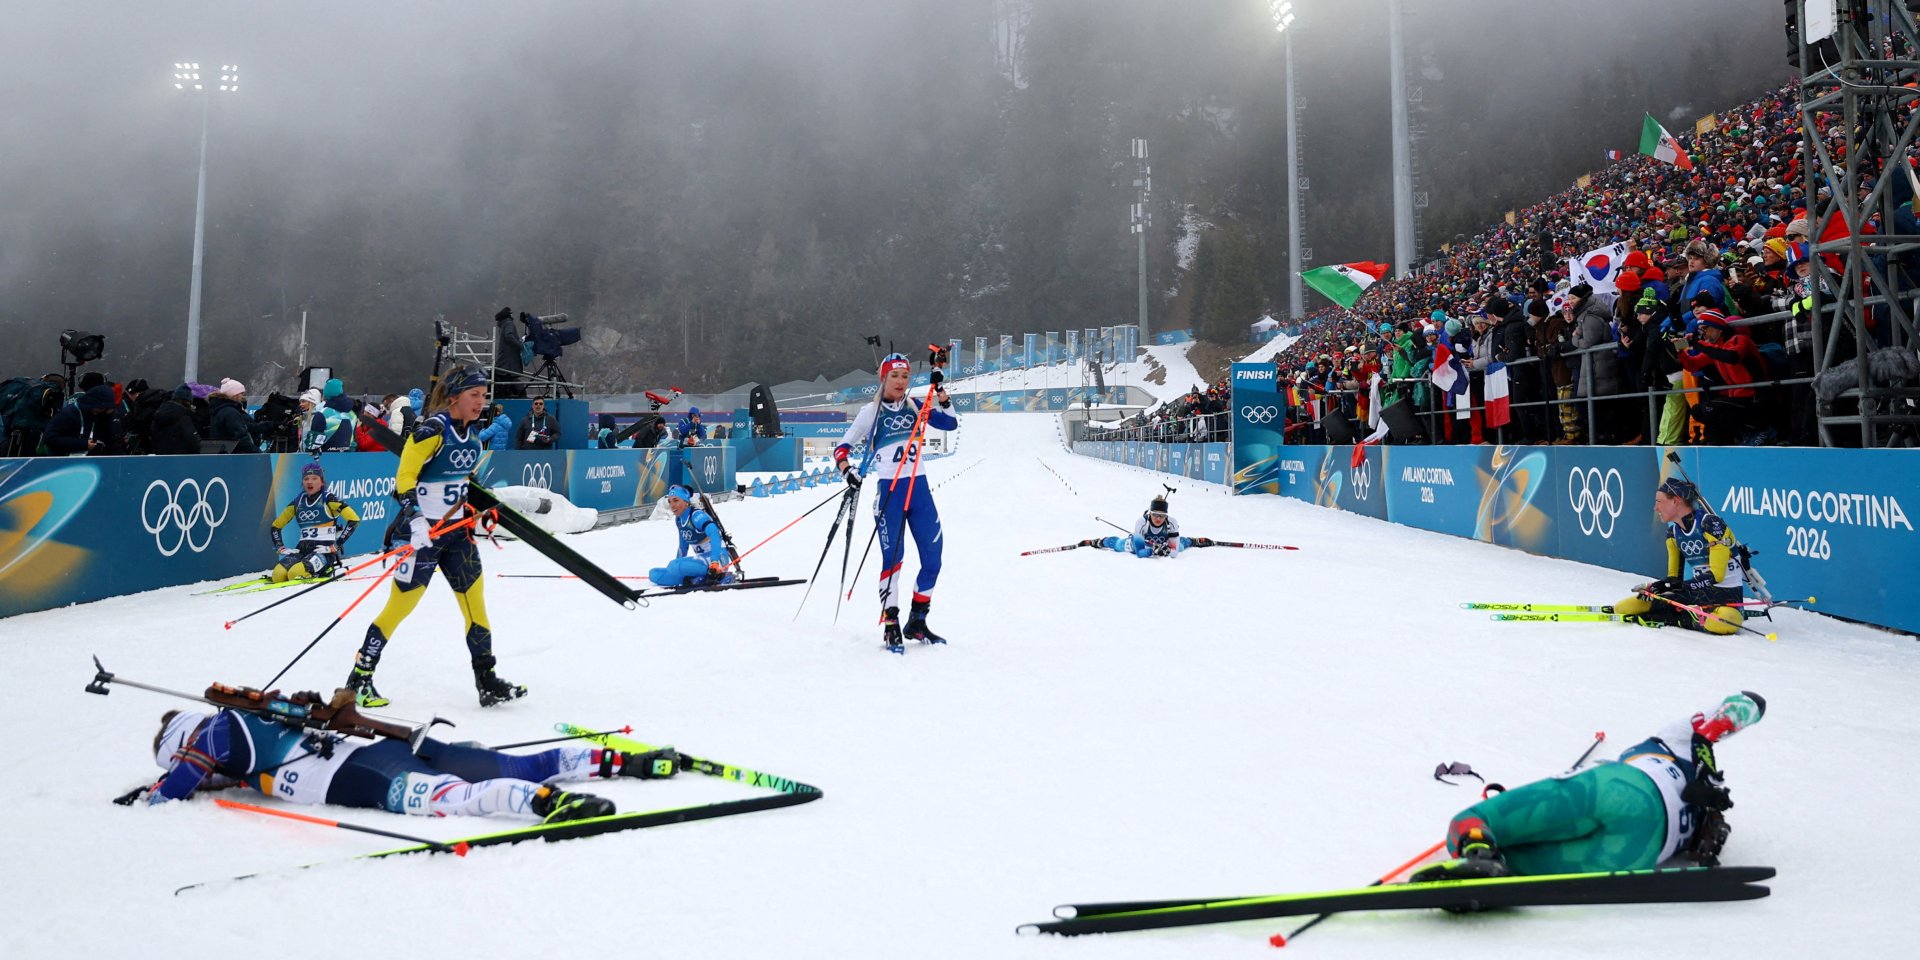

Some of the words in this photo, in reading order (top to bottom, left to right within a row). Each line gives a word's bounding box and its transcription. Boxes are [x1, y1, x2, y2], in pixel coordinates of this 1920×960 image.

[1236, 369, 1273, 381] FINISH
[816, 427, 844, 435] MILANO
[892, 443, 918, 465] 49
[586, 466, 606, 480] MILANO
[606, 464, 626, 479] CORTINA
[1402, 465, 1427, 483] MILANO
[1427, 467, 1455, 487] CORTINA
[326, 477, 373, 500] MILANO
[374, 476, 397, 497] COR
[600, 480, 612, 493] 2026
[1420, 486, 1434, 503] 2026
[362, 500, 386, 521] 2026
[1720, 484, 1803, 520] MILANO
[1806, 490, 1915, 532] CORTINA
[878, 512, 891, 551] OREA
[1785, 524, 1832, 561] 2026
[1690, 580, 1711, 590] SWE
[1472, 603, 1519, 611] FISCHER
[1501, 614, 1547, 622] FISCHER
[369, 636, 382, 657] SW
[279, 769, 299, 797] 56
[407, 781, 430, 810] 56
